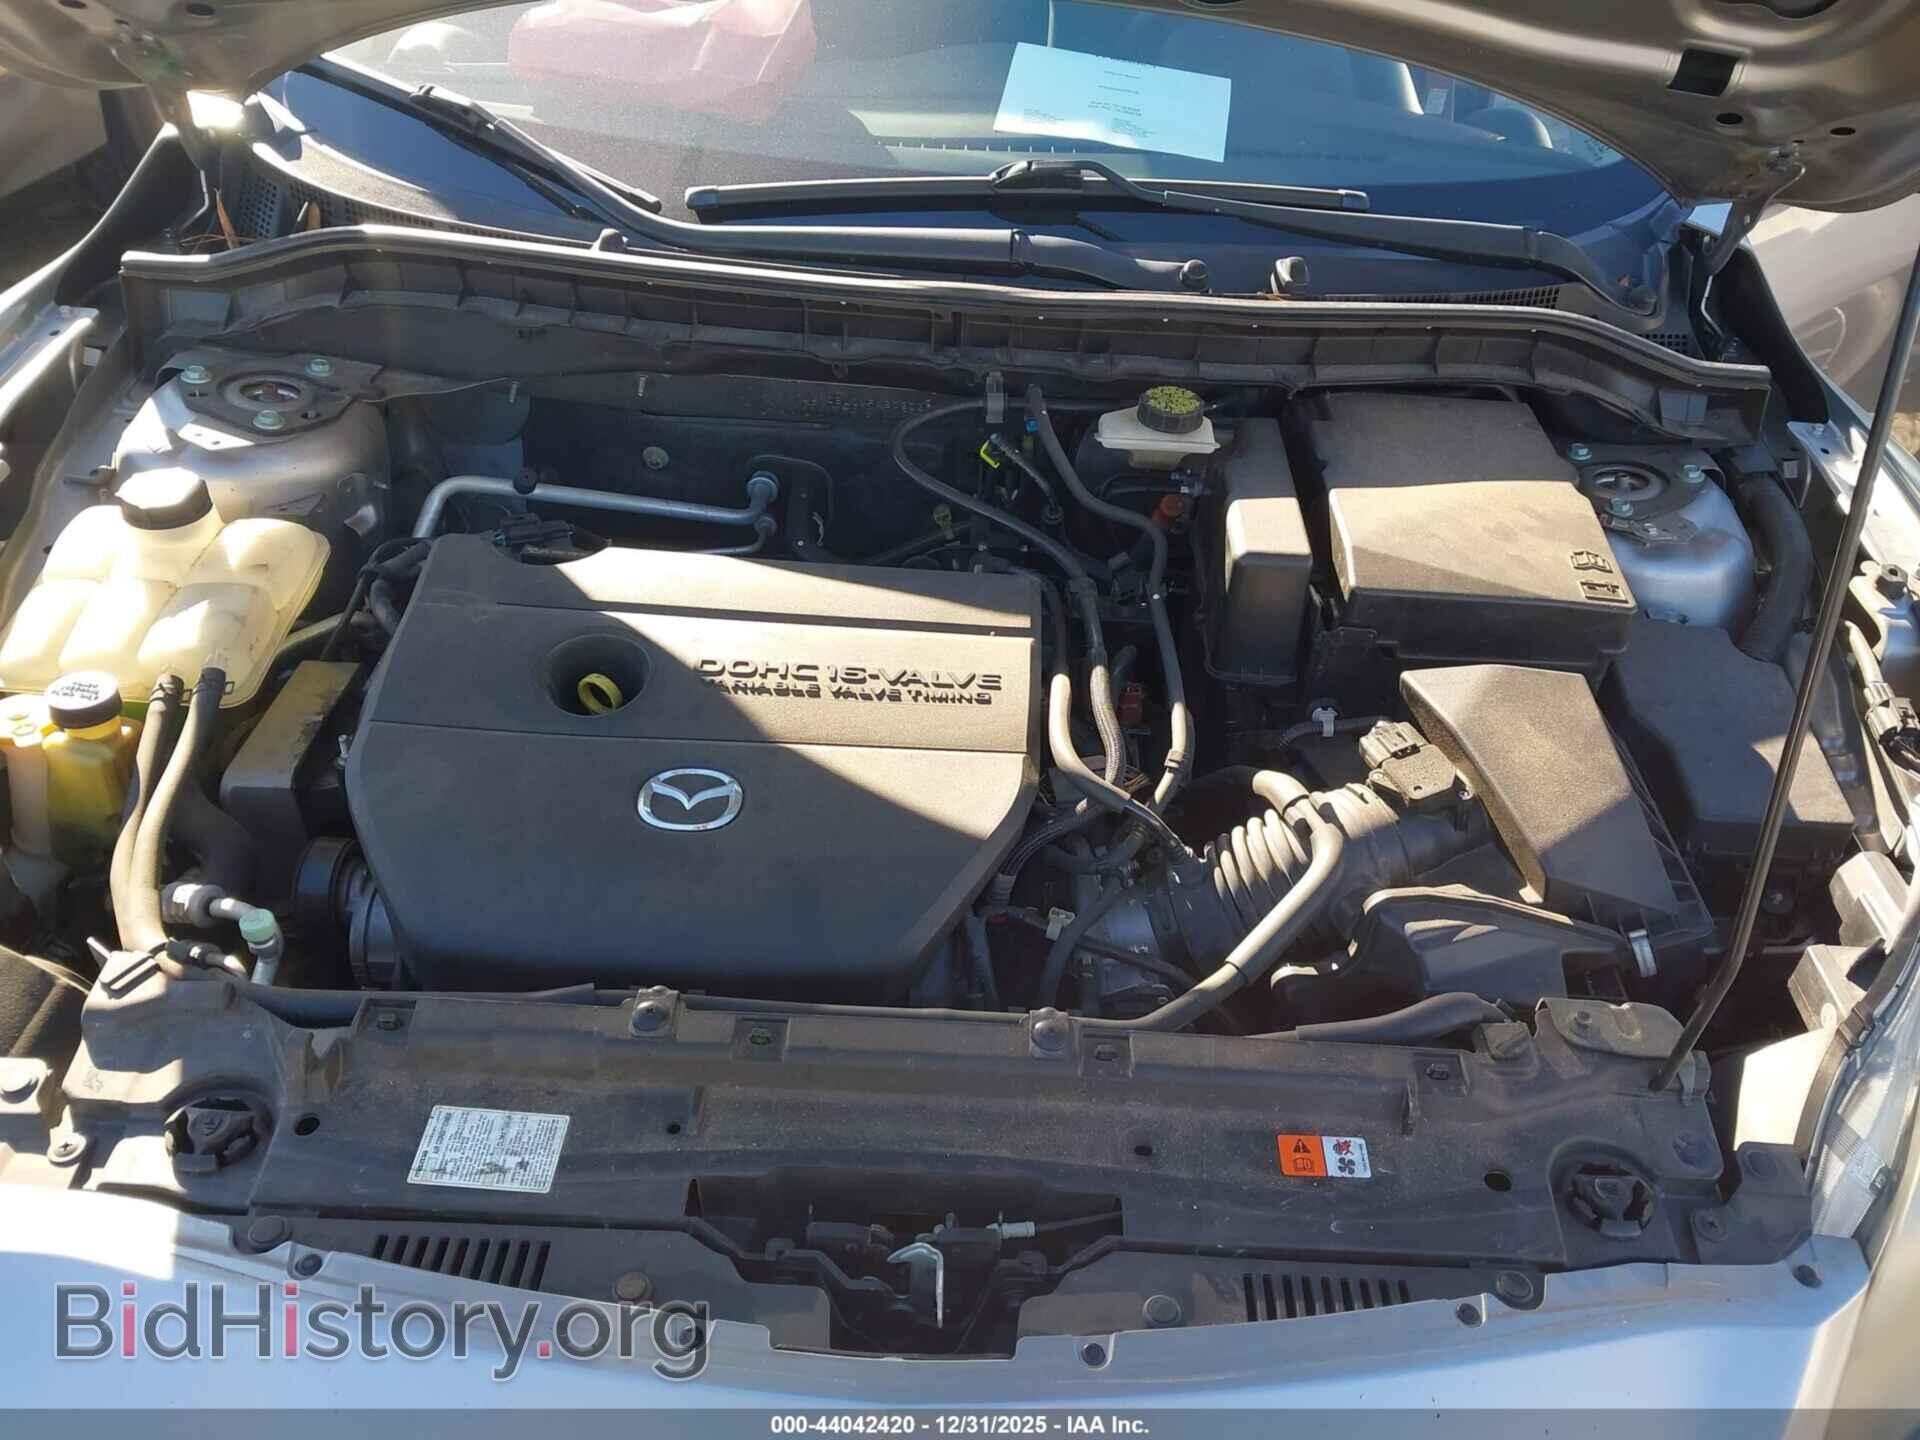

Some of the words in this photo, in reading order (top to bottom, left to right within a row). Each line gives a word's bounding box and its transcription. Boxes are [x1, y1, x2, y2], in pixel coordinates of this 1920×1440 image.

[699, 658, 820, 682] DOHC
[830, 685, 902, 702] VALVE
[907, 689, 993, 706] TIMING
